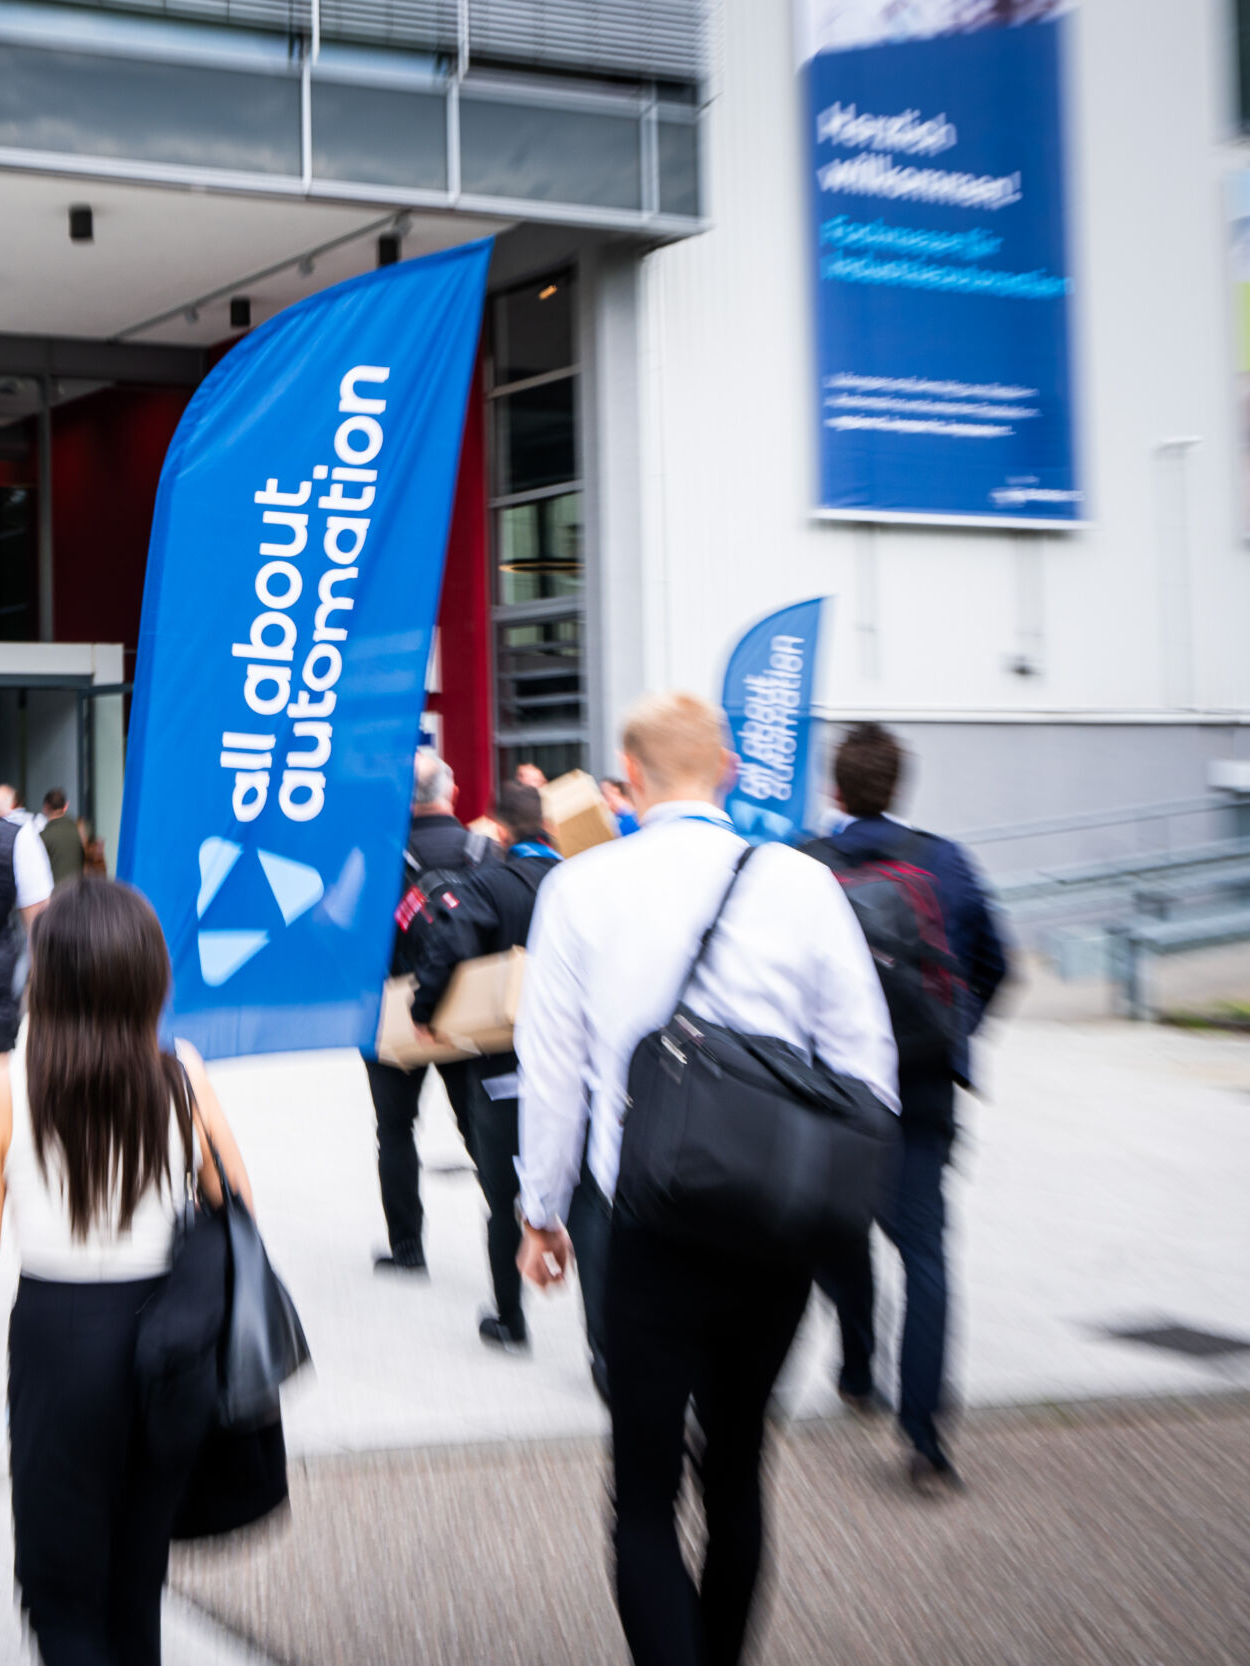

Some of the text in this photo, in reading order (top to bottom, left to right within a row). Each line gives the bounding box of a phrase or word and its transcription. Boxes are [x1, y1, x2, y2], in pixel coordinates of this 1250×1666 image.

[219, 477, 313, 823] all about
[278, 364, 391, 823] automation
